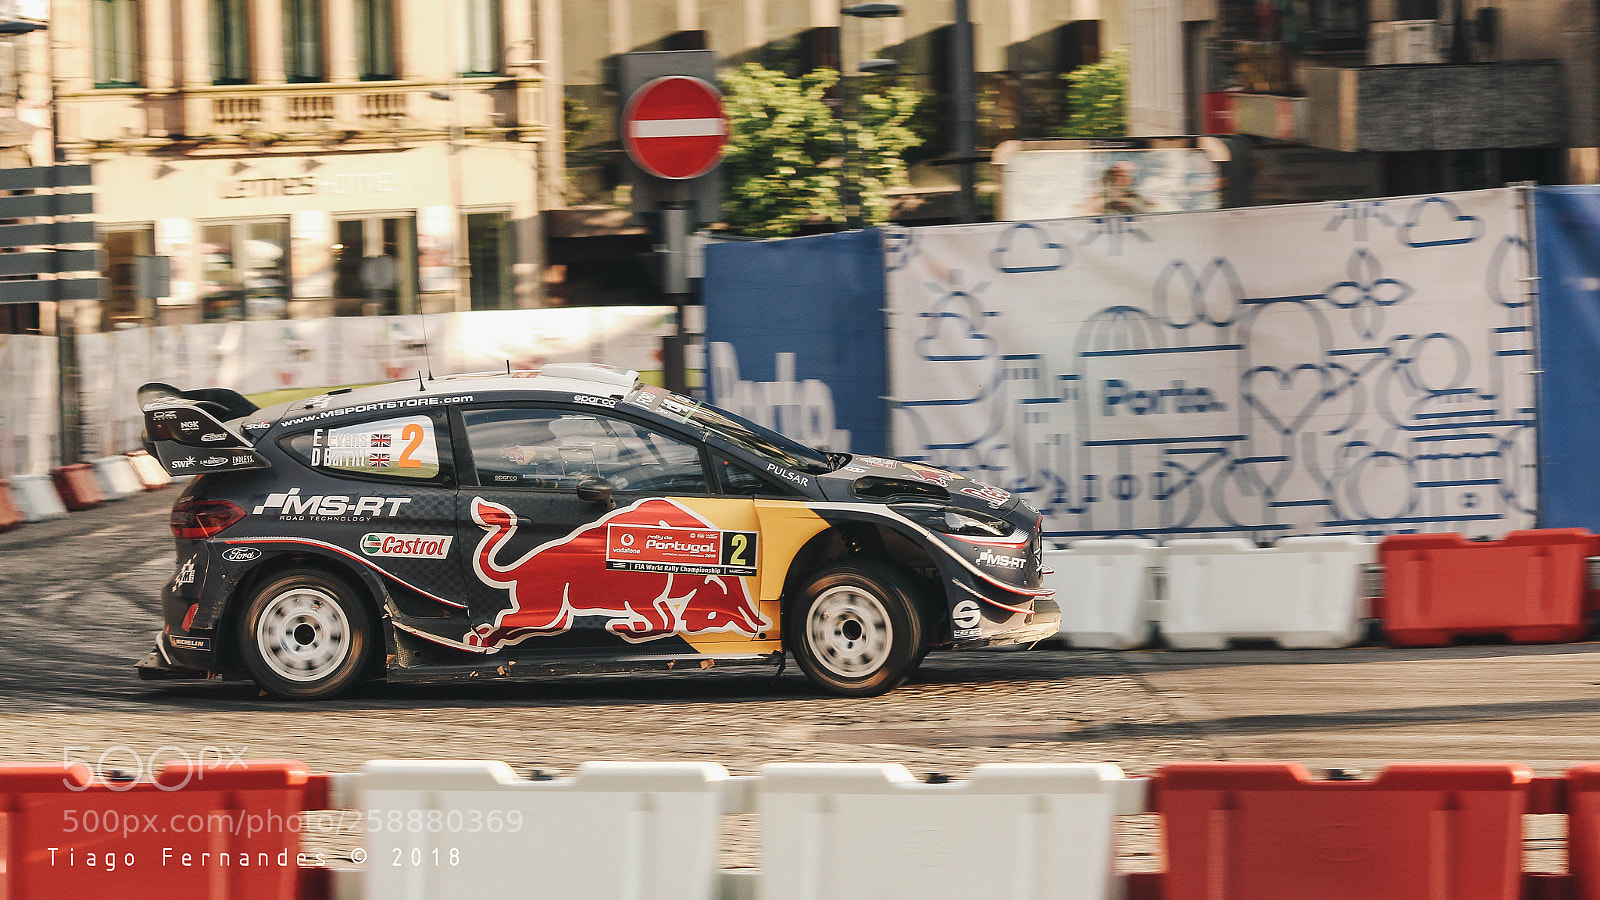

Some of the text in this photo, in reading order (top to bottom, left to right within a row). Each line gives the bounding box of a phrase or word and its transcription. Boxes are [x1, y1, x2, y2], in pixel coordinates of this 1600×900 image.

[280, 395, 474, 428] www.MSPORTSTORE.com
[312, 428, 368, 447] E Evans
[398, 423, 425, 468] 2
[172, 460, 191, 468] SWP
[311, 449, 320, 467] D
[766, 463, 809, 487] PULSAR
[281, 495, 412, 517] MS-RT
[228, 547, 255, 560] Ford
[382, 536, 445, 556] Castrol
[645, 540, 717, 553] Portugal
[730, 534, 748, 566] 2
[664, 565, 679, 573] Rally
[680, 566, 721, 575] Championship
[986, 554, 1027, 569] MS-RT
